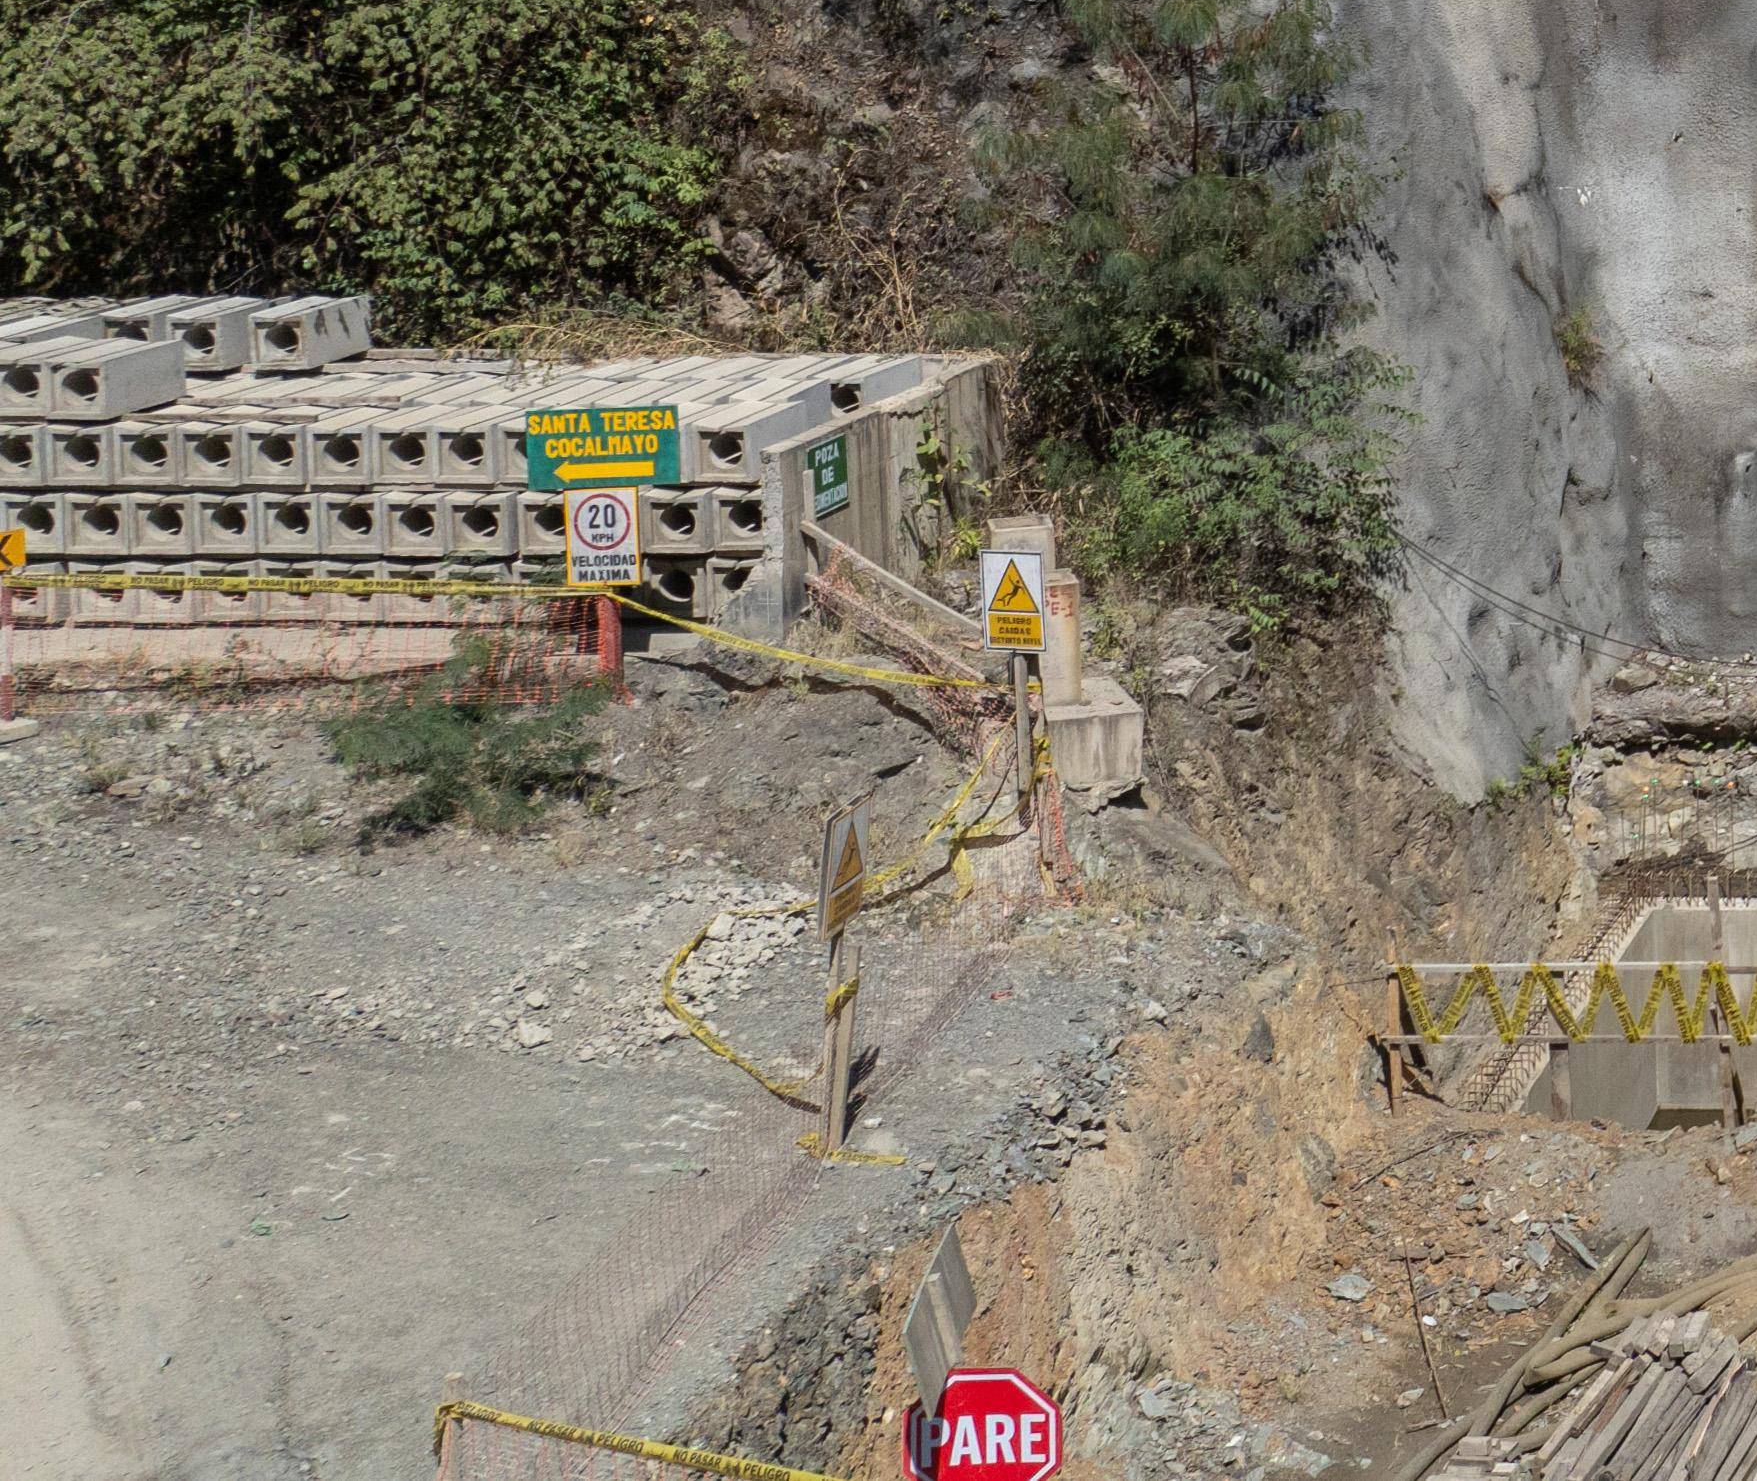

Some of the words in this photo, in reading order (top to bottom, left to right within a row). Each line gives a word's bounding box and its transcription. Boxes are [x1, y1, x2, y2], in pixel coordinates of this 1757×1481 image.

[528, 412, 591, 435] SANTA
[601, 410, 676, 432] TERESA
[545, 434, 659, 458] COCALMAYO
[815, 442, 840, 467] POZA
[822, 466, 835, 485] DE
[588, 504, 616, 529] 20
[592, 533, 614, 543] KPH
[572, 554, 637, 567] VELOCIDAD
[303, 580, 340, 588] PELIGRO
[578, 569, 631, 581] MAXIMA
[997, 617, 1032, 625] PELIGRO
[920, 1413, 1046, 1467] PARE
[544, 1421, 577, 1437] PASAR
[597, 1433, 645, 1453] PELIGRO
[673, 1449, 686, 1461] NO
[689, 1452, 721, 1468] PASAR
[743, 1463, 790, 1481] PELIGRO
